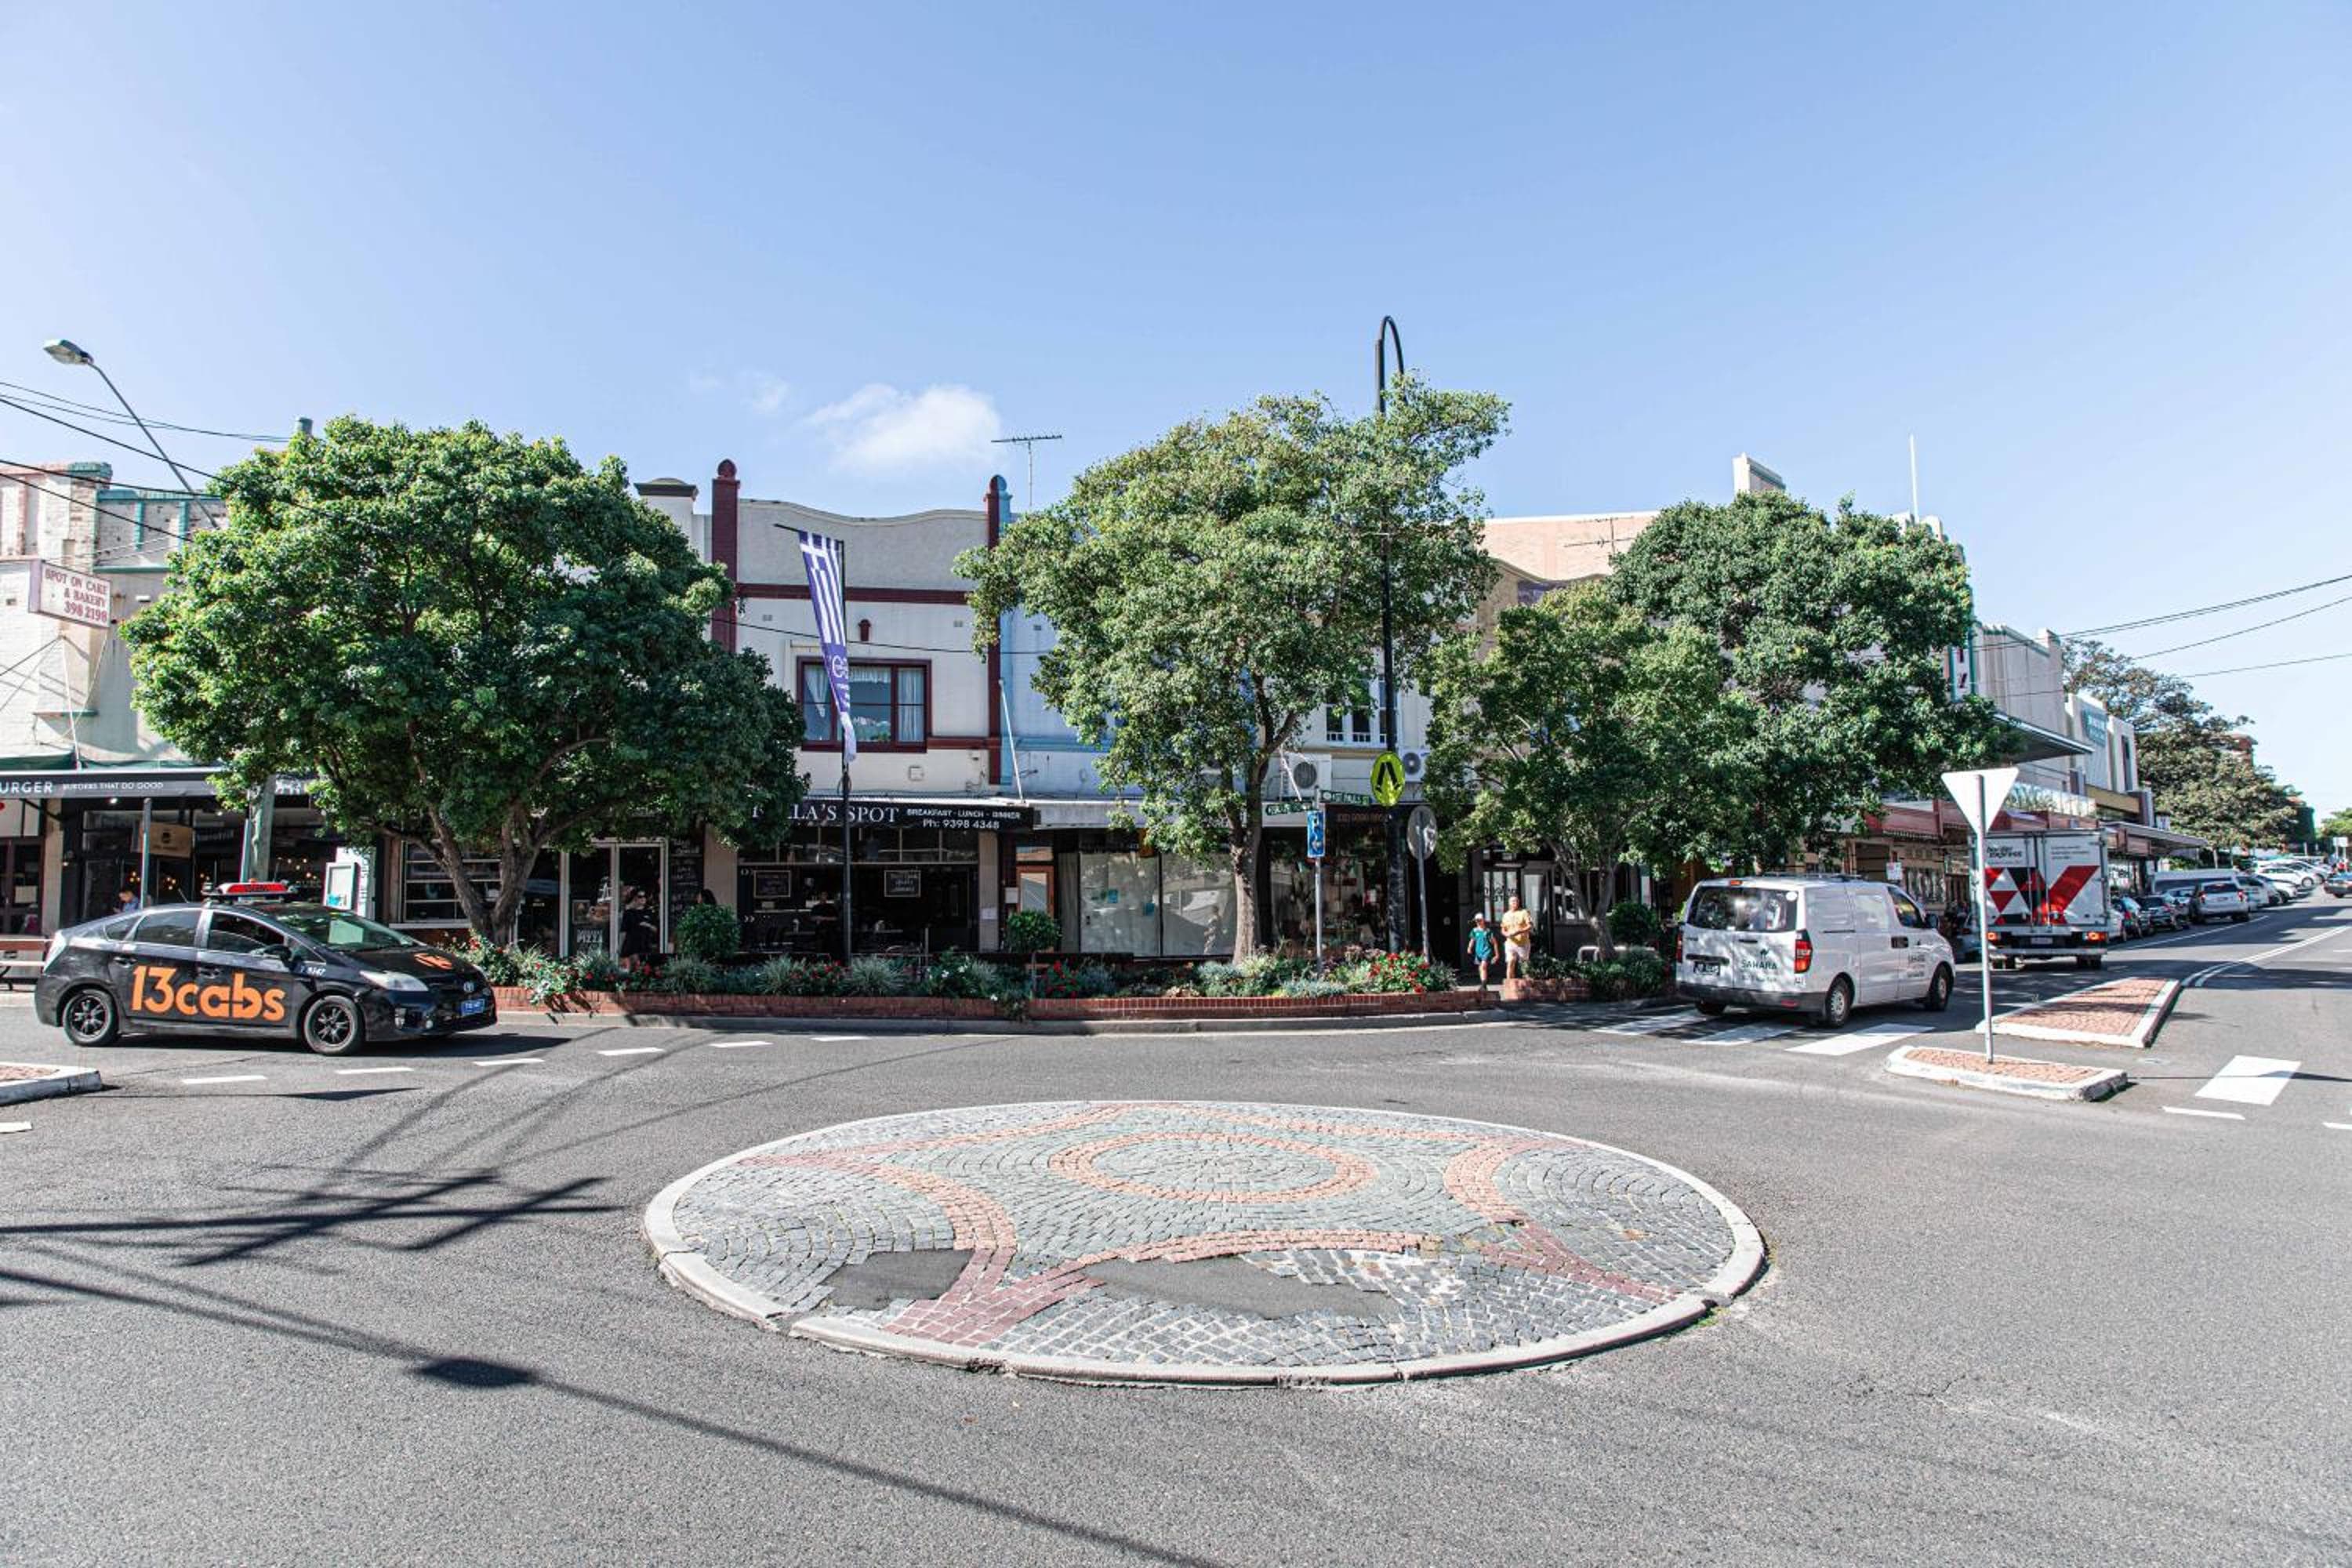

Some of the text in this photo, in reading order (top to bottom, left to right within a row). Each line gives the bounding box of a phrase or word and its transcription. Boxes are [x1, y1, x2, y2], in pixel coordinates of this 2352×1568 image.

[45, 568, 107, 595] SPOT ON CAKE
[74, 590, 106, 608] BAKERY
[64, 601, 107, 623] 398 2198
[100, 782, 119, 790] THAT
[122, 782, 135, 790] DO
[137, 782, 164, 790] GOOD
[847, 805, 899, 822] SPOT
[906, 808, 1022, 819] BREAKFAST LUNCH DINNER
[923, 818, 1000, 829] Ph: 9398 4348
[576, 933, 603, 943] PIZZA
[1740, 959, 1777, 970] SAHARA
[132, 965, 285, 1022] 13cabs
